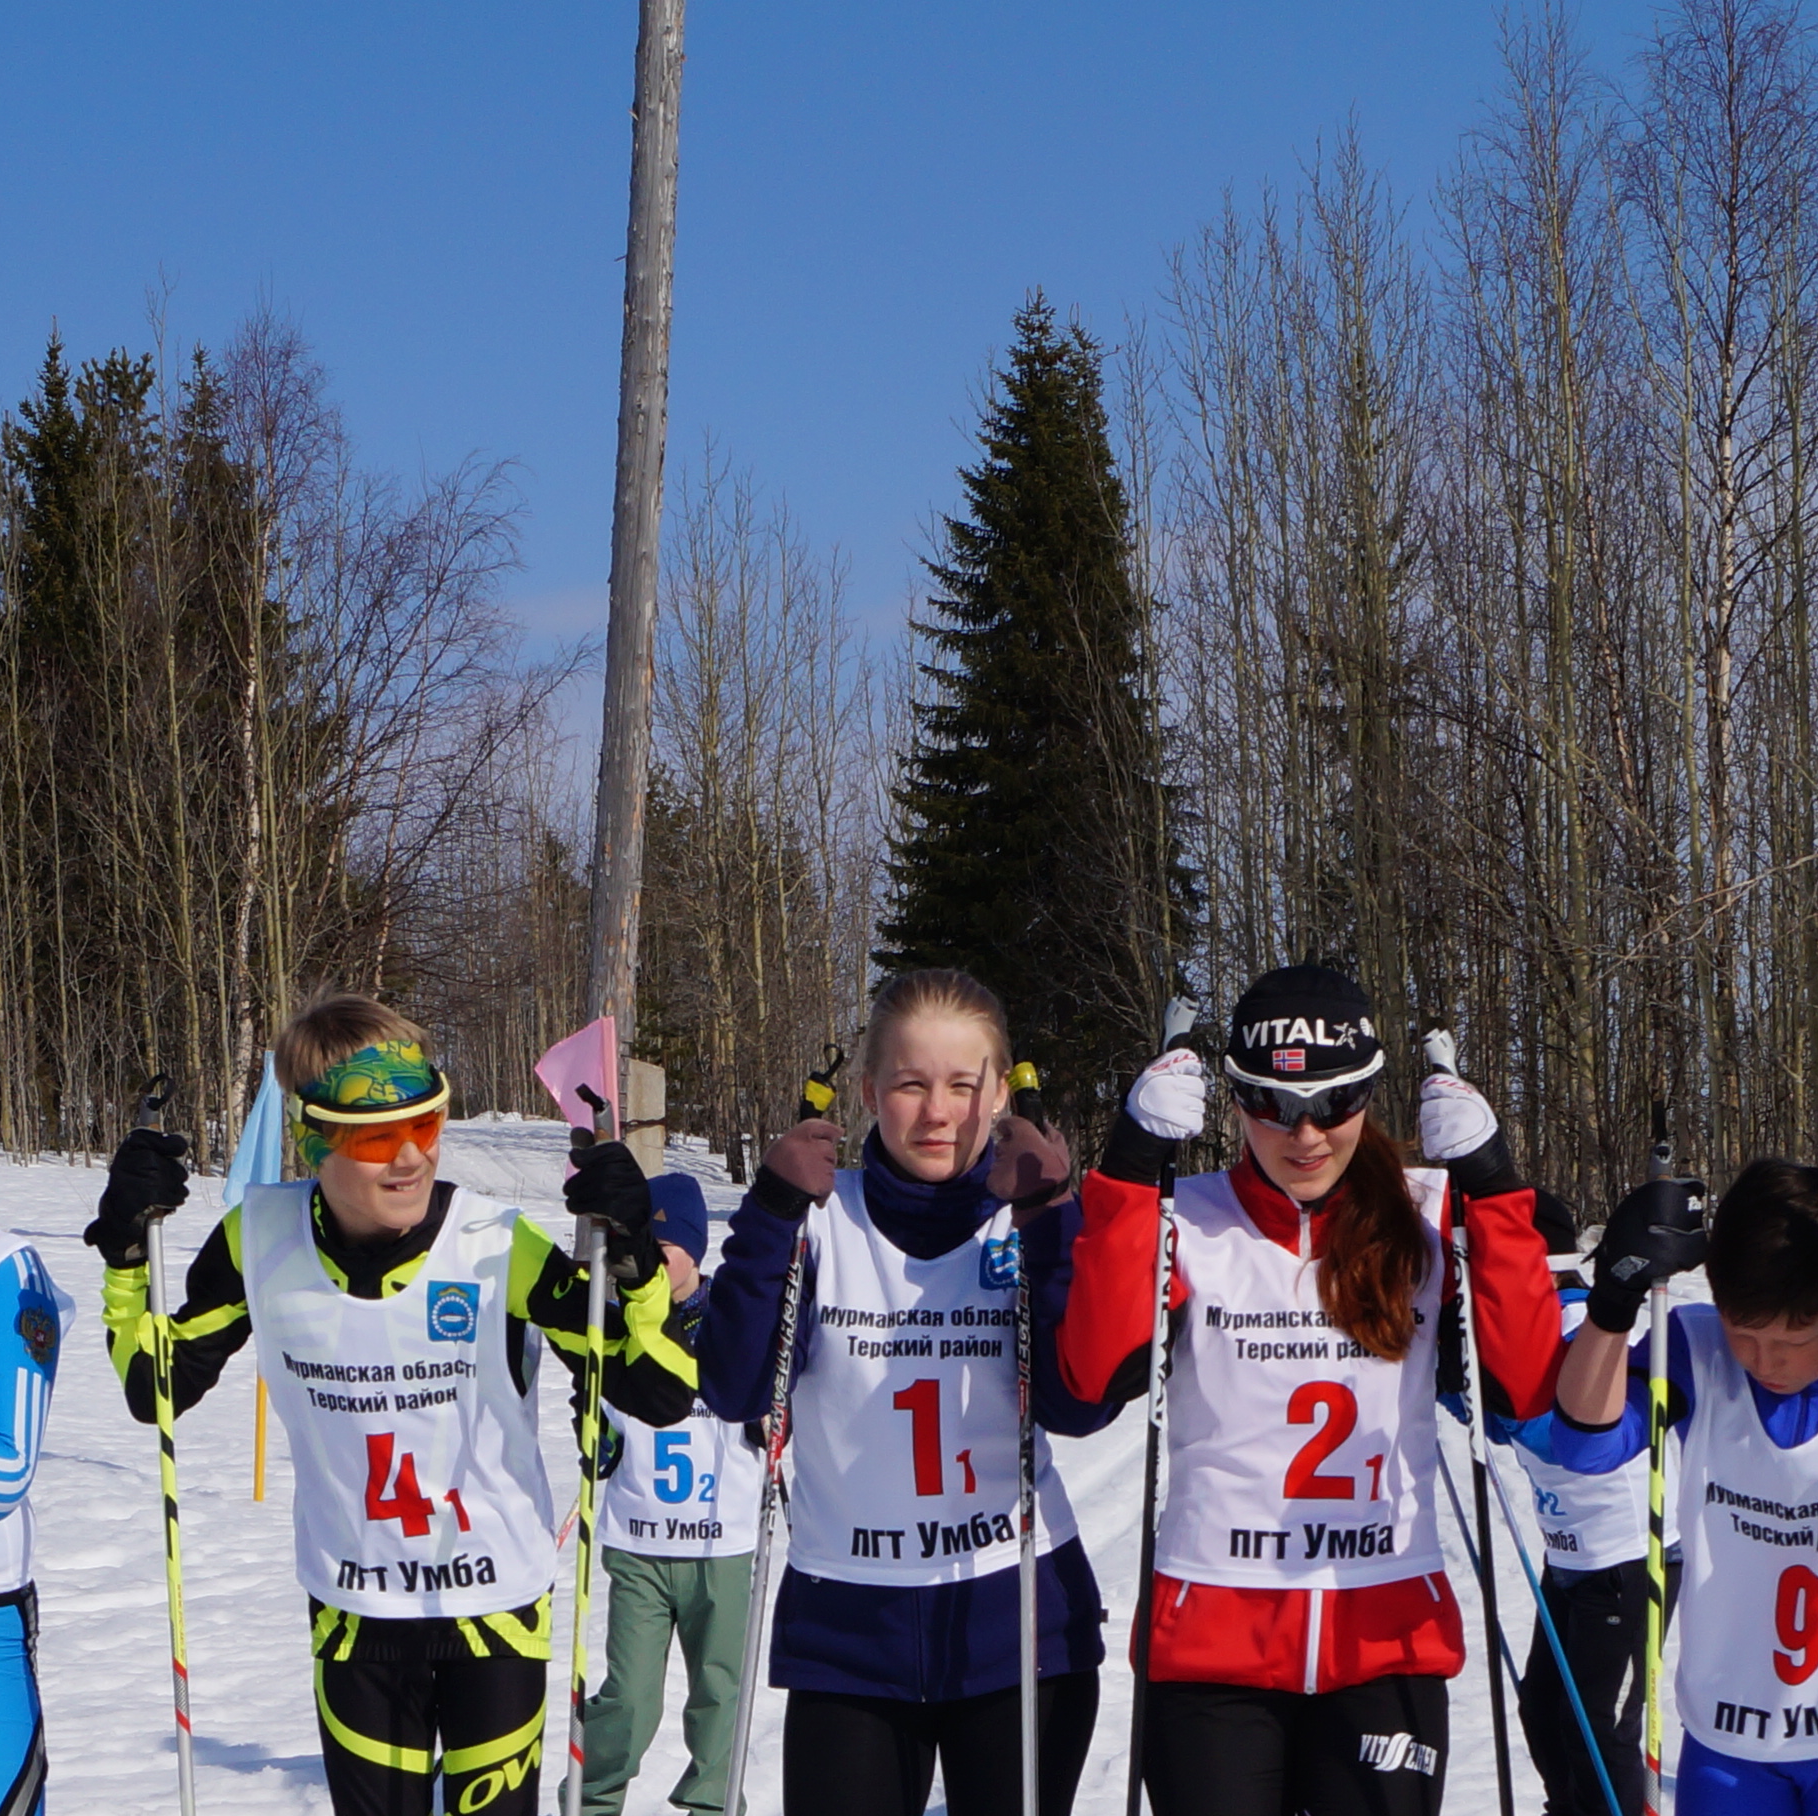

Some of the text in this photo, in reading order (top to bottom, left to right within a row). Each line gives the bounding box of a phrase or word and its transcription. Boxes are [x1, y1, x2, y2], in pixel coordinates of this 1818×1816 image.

[819, 1304, 1019, 1329] Мурманская област
[1206, 1306, 1333, 1329] Мурманска
[847, 1335, 1002, 1360] Терский район
[1236, 1336, 1329, 1361] Терский
[284, 1351, 395, 1383] Мурманская
[307, 1387, 459, 1414] Терский район
[690, 1405, 715, 1419] айо
[893, 1379, 976, 1496] 1 1
[1283, 1380, 1384, 1501] 2 1
[365, 1431, 471, 1539] 4 1
[653, 1431, 716, 1503] 5 2
[629, 1517, 723, 1541] пгт Умба
[851, 1511, 1015, 1559] пгт Умба
[1230, 1522, 1394, 1560] пгт Умба
[1730, 1512, 1814, 1548] Терский
[338, 1553, 497, 1593] пгт Умба
[1714, 1701, 1772, 1740] пгт
